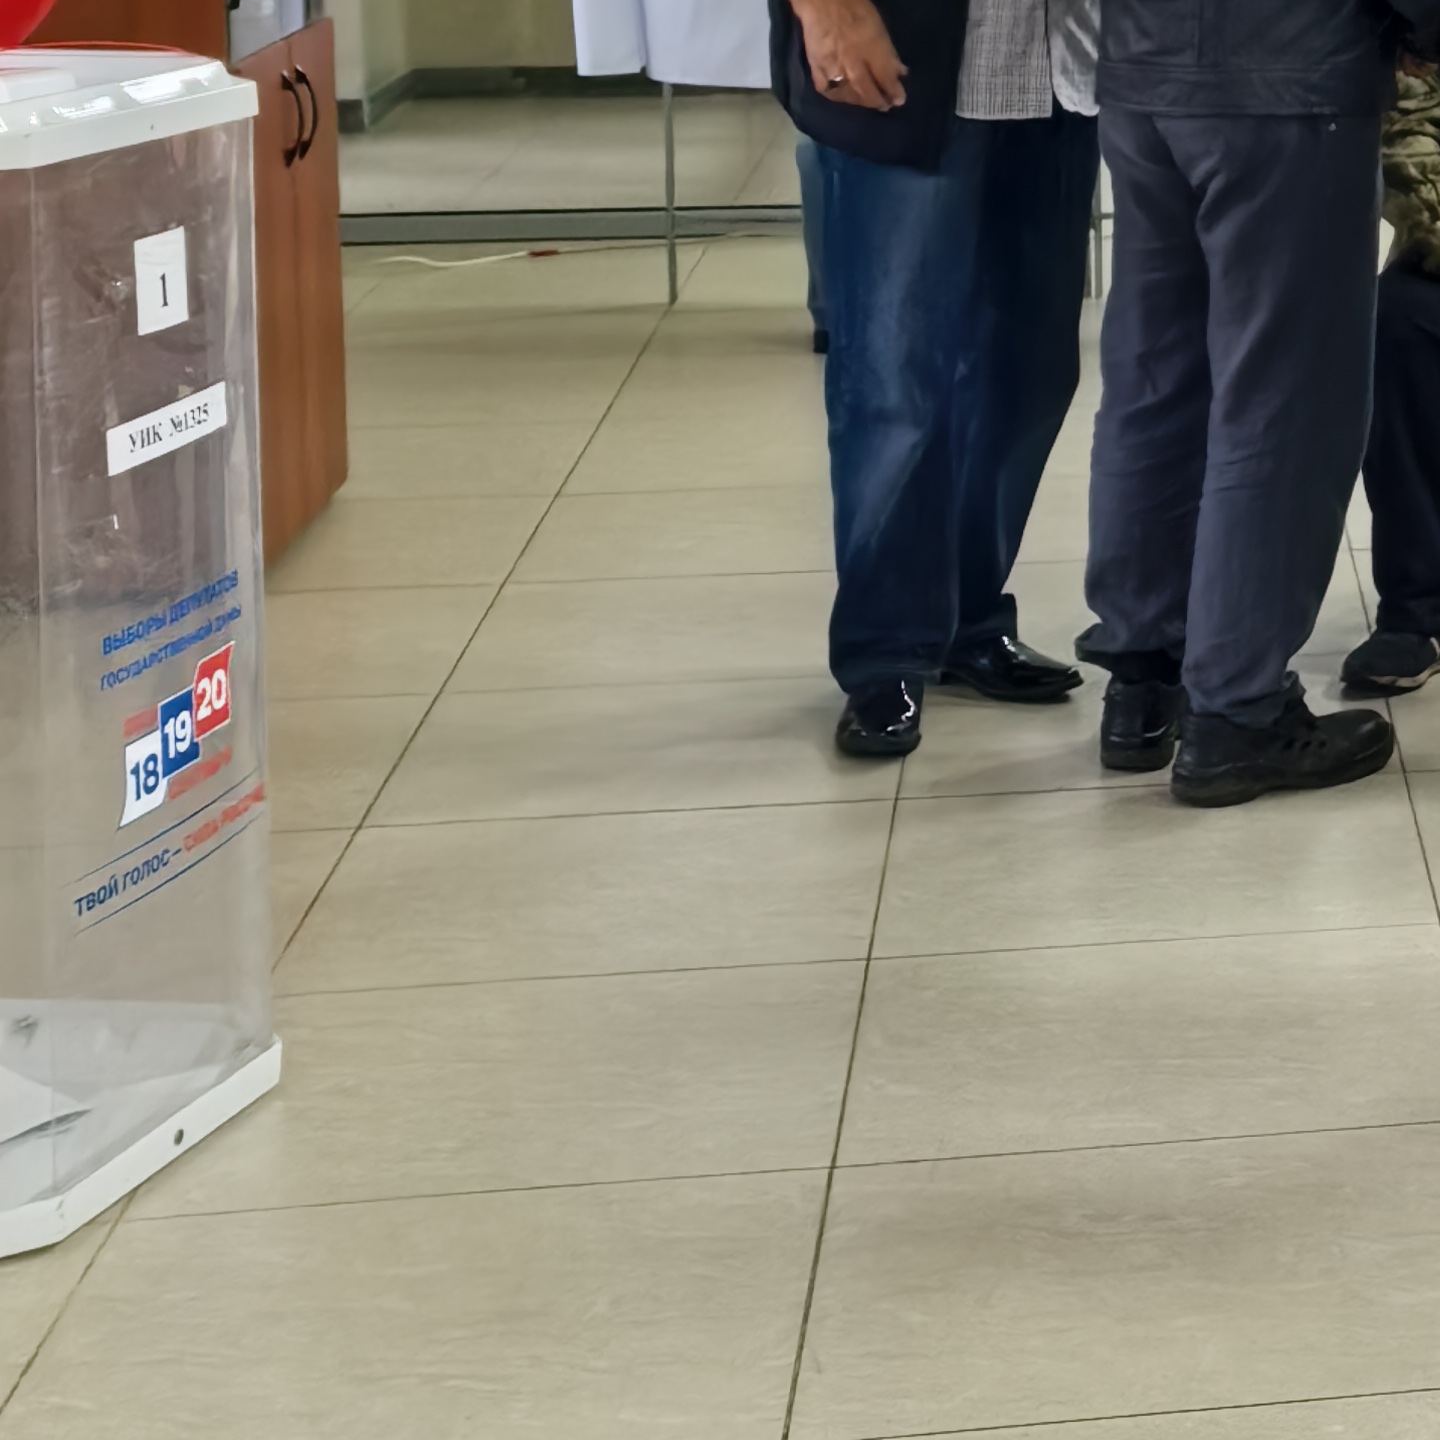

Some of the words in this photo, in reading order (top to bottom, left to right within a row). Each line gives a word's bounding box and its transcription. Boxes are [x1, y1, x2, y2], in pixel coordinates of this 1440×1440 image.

[159, 272, 170, 308] 1
[127, 422, 164, 454] УИК
[102, 609, 167, 656] ВЫБОРЫ
[130, 753, 160, 802] 18
[163, 710, 192, 760] 19
[196, 668, 227, 721] 20
[74, 872, 119, 917] ТВОЙ
[122, 847, 171, 892] ГОЛОС
